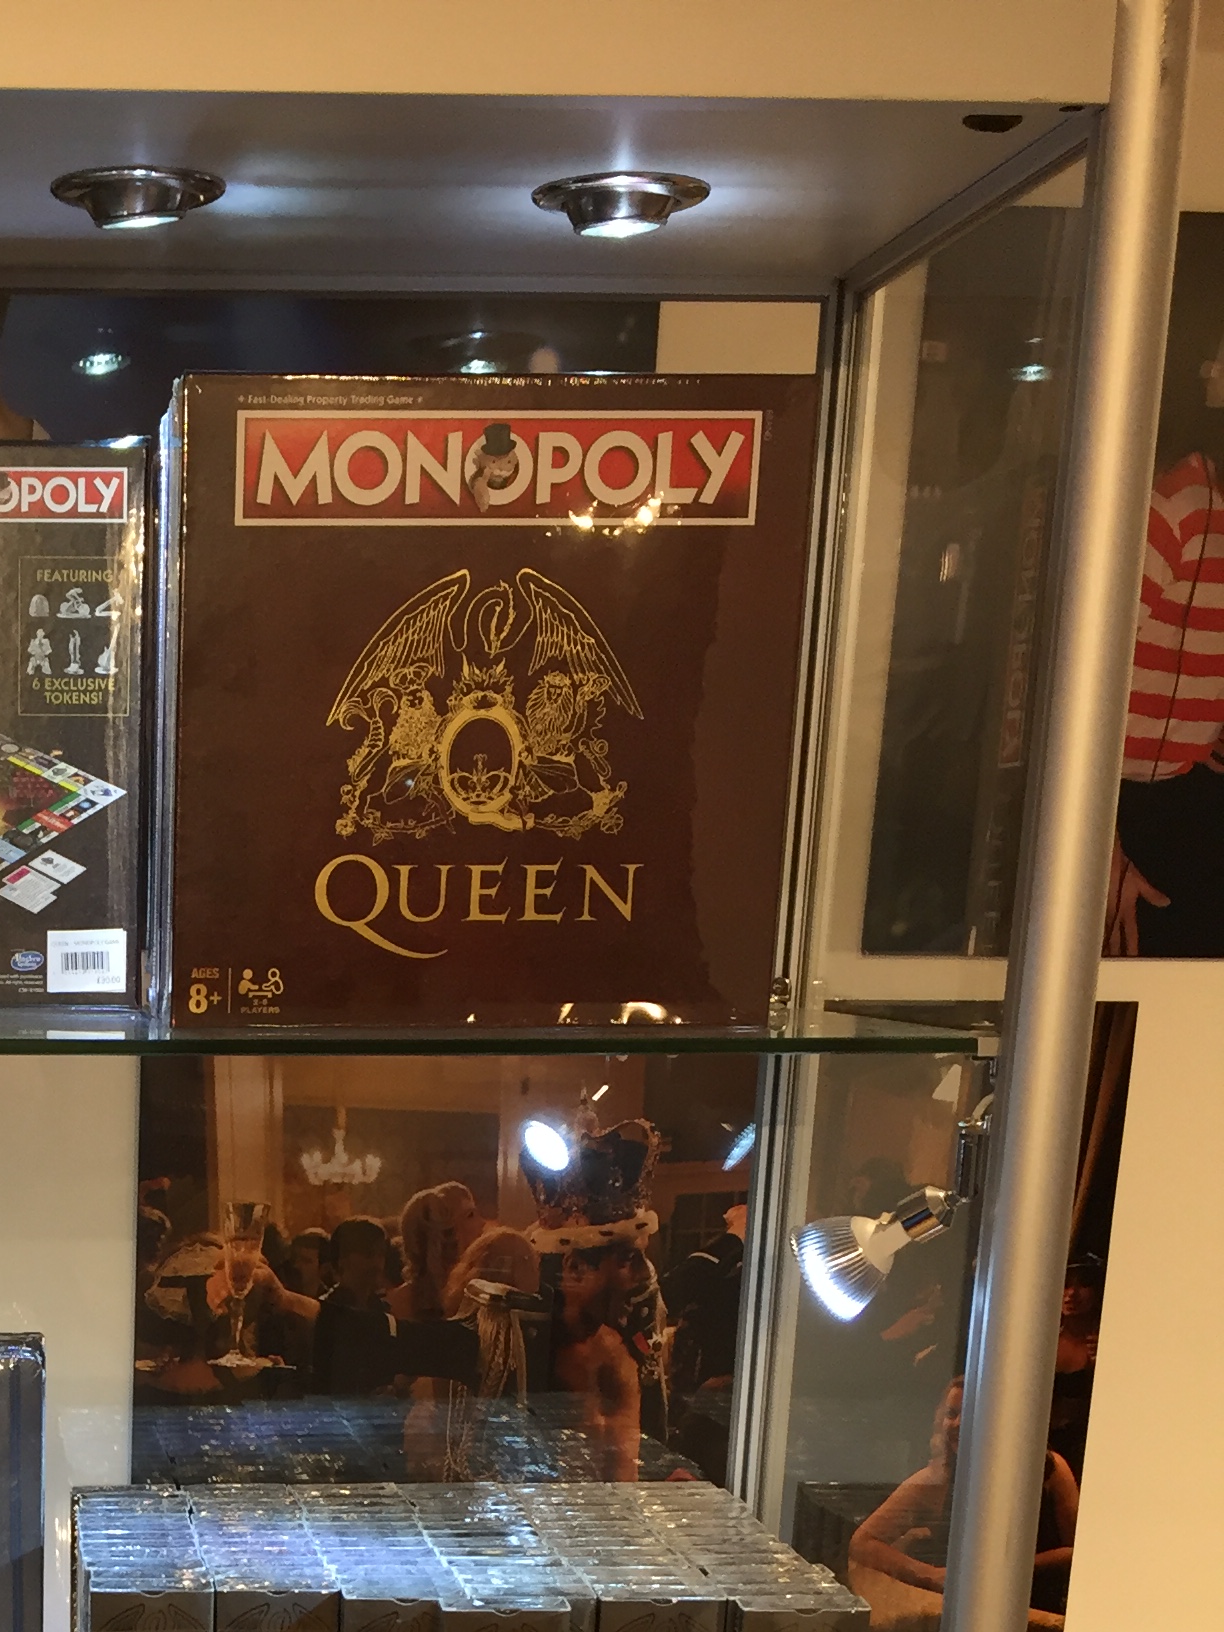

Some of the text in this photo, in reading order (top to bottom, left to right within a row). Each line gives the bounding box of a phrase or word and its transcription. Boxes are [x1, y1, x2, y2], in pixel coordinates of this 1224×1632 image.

[247, 394, 413, 406] Fast-Dealing Property Trading Game
[256, 429, 746, 507] MONOPOLY
[36, 569, 114, 583] FEATURING
[32, 677, 116, 691] 6 EXCLUSIVE
[44, 691, 103, 705] TOKENS!
[315, 854, 644, 959] QUEEN
[190, 967, 221, 979] AGES
[188, 983, 223, 1014] 8+
[240, 1006, 281, 1014] PLAYERS
